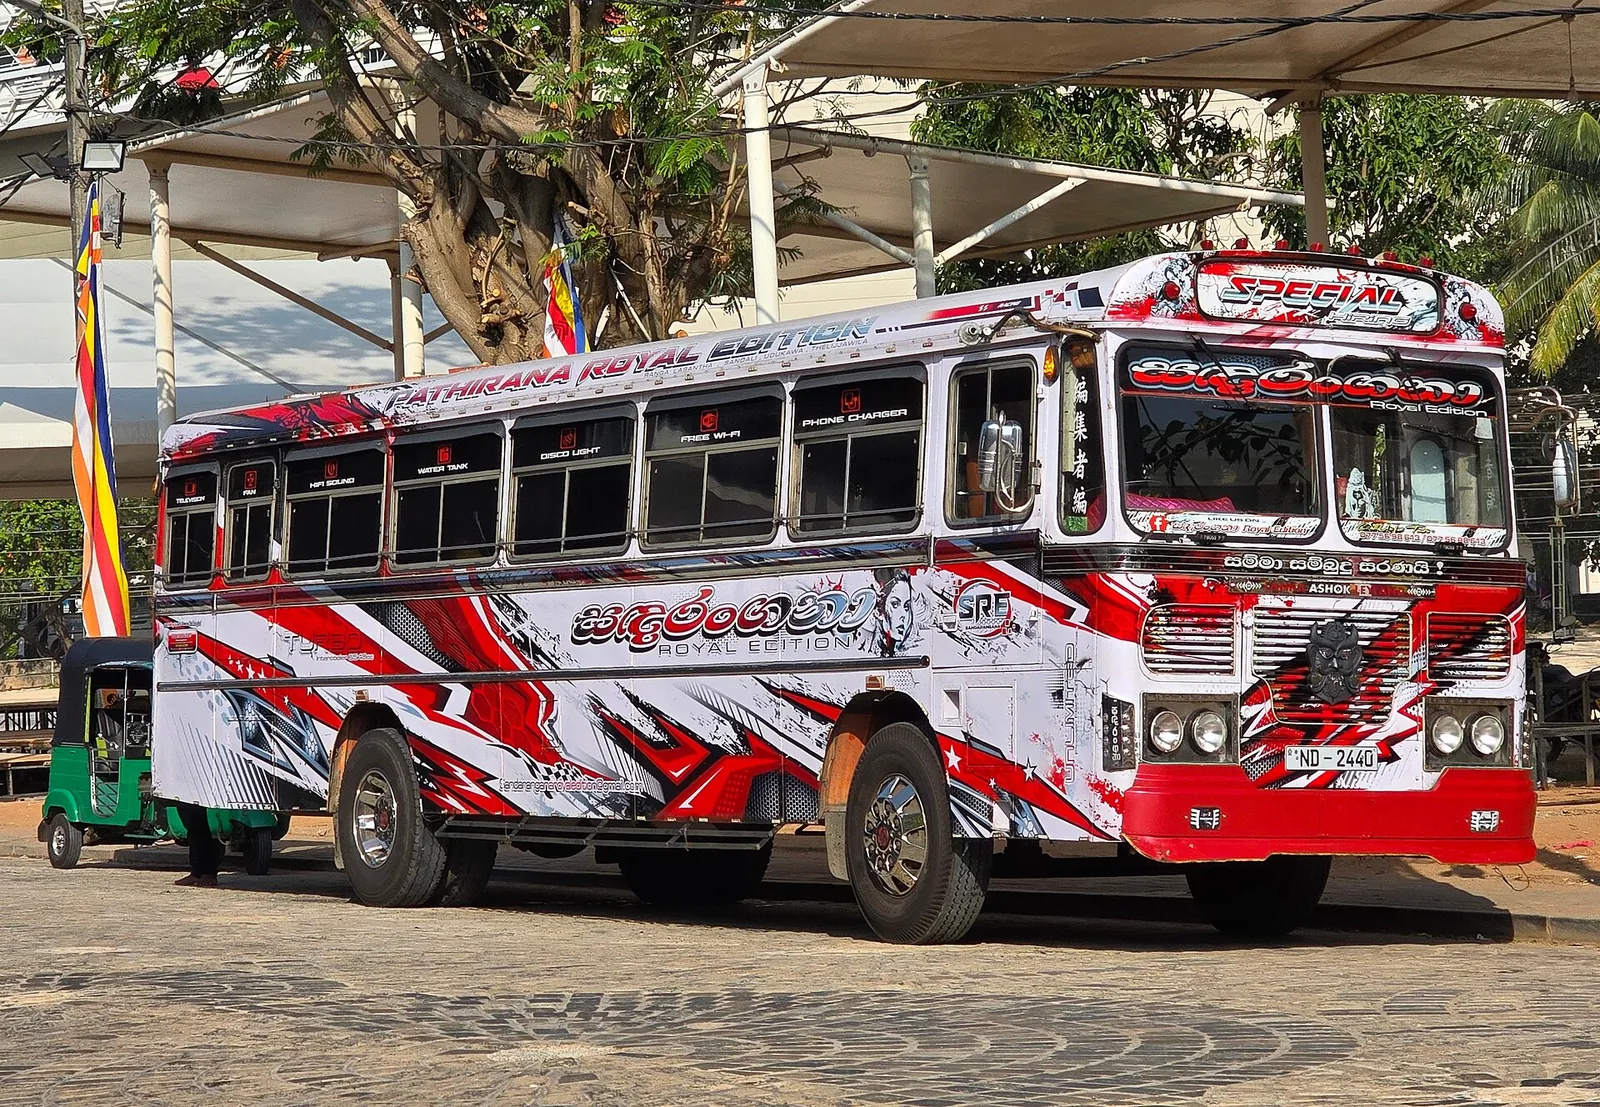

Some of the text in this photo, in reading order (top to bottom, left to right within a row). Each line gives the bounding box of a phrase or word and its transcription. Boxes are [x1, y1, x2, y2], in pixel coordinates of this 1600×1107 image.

[1221, 275, 1402, 314] SPECIAL
[386, 316, 879, 411] PATHIRANA ROYAL EDITION
[1370, 400, 1488, 417] Royal Edition
[802, 408, 908, 427] PHONE CHARGER
[680, 430, 741, 443] FREE WI-FI
[540, 446, 601, 460] DISCO LIGHT
[417, 462, 469, 475] WATER TANK
[309, 477, 355, 489] HIFI SOUND
[242, 488, 257, 496] FAN
[1242, 524, 1271, 535] Royal
[1309, 583, 1351, 595] ASHOK
[959, 592, 1010, 623] SRE
[658, 635, 852, 657] ROYAL EDITION
[1300, 749, 1320, 767] ND
[1337, 749, 1374, 767] 2440
